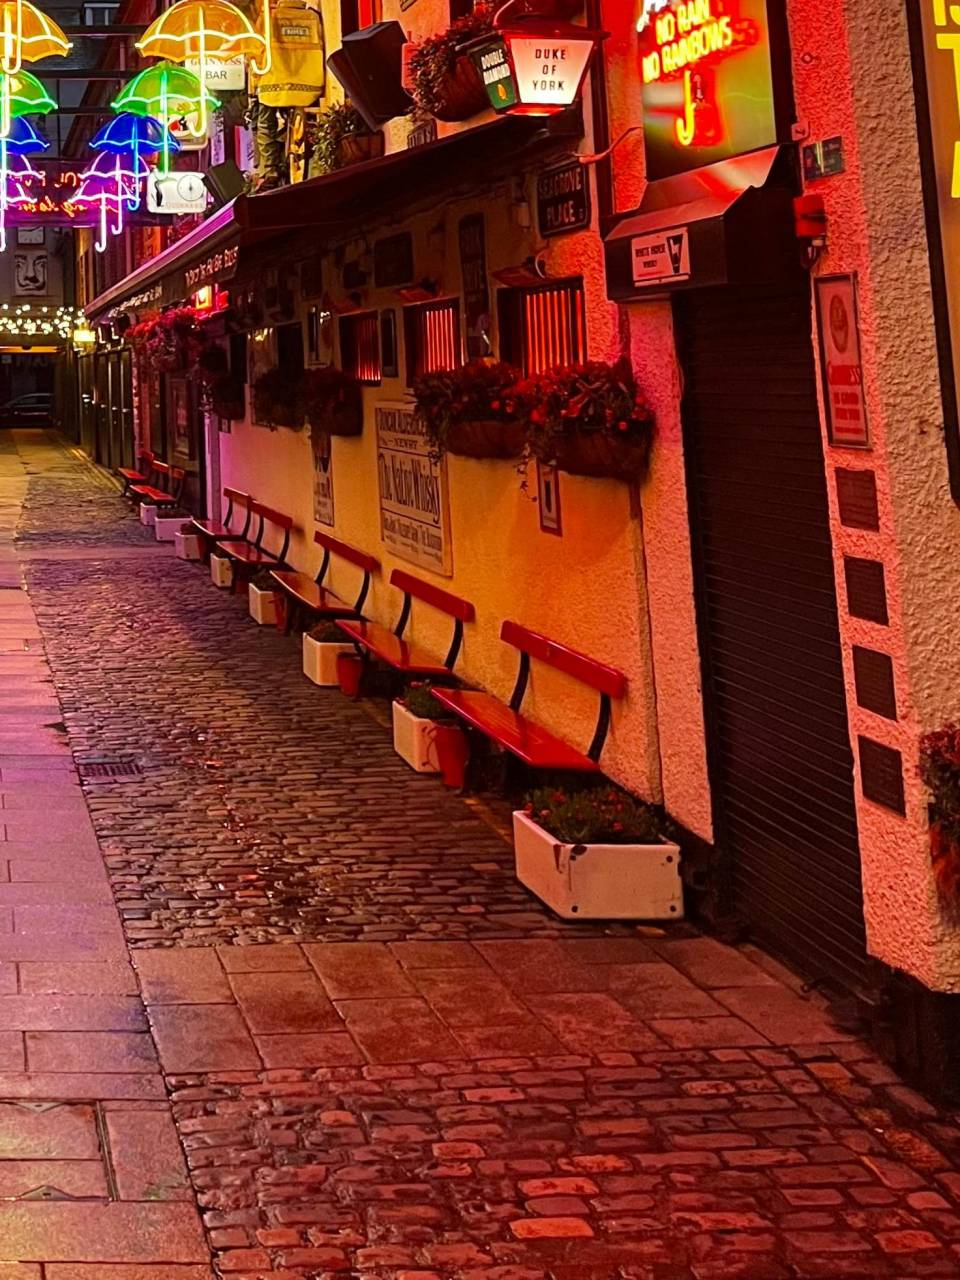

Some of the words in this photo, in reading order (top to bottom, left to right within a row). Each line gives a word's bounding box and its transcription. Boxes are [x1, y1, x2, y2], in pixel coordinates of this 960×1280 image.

[656, 13, 675, 45] NO
[535, 49, 566, 60] DUKE
[642, 52, 660, 83] NO
[662, 16, 733, 73] RAINBOWS
[481, 48, 504, 70] DOUBLE
[206, 70, 228, 80] BAR
[483, 63, 511, 85] DIAMOND
[542, 64, 557, 75] OF
[532, 80, 565, 91] YORK
